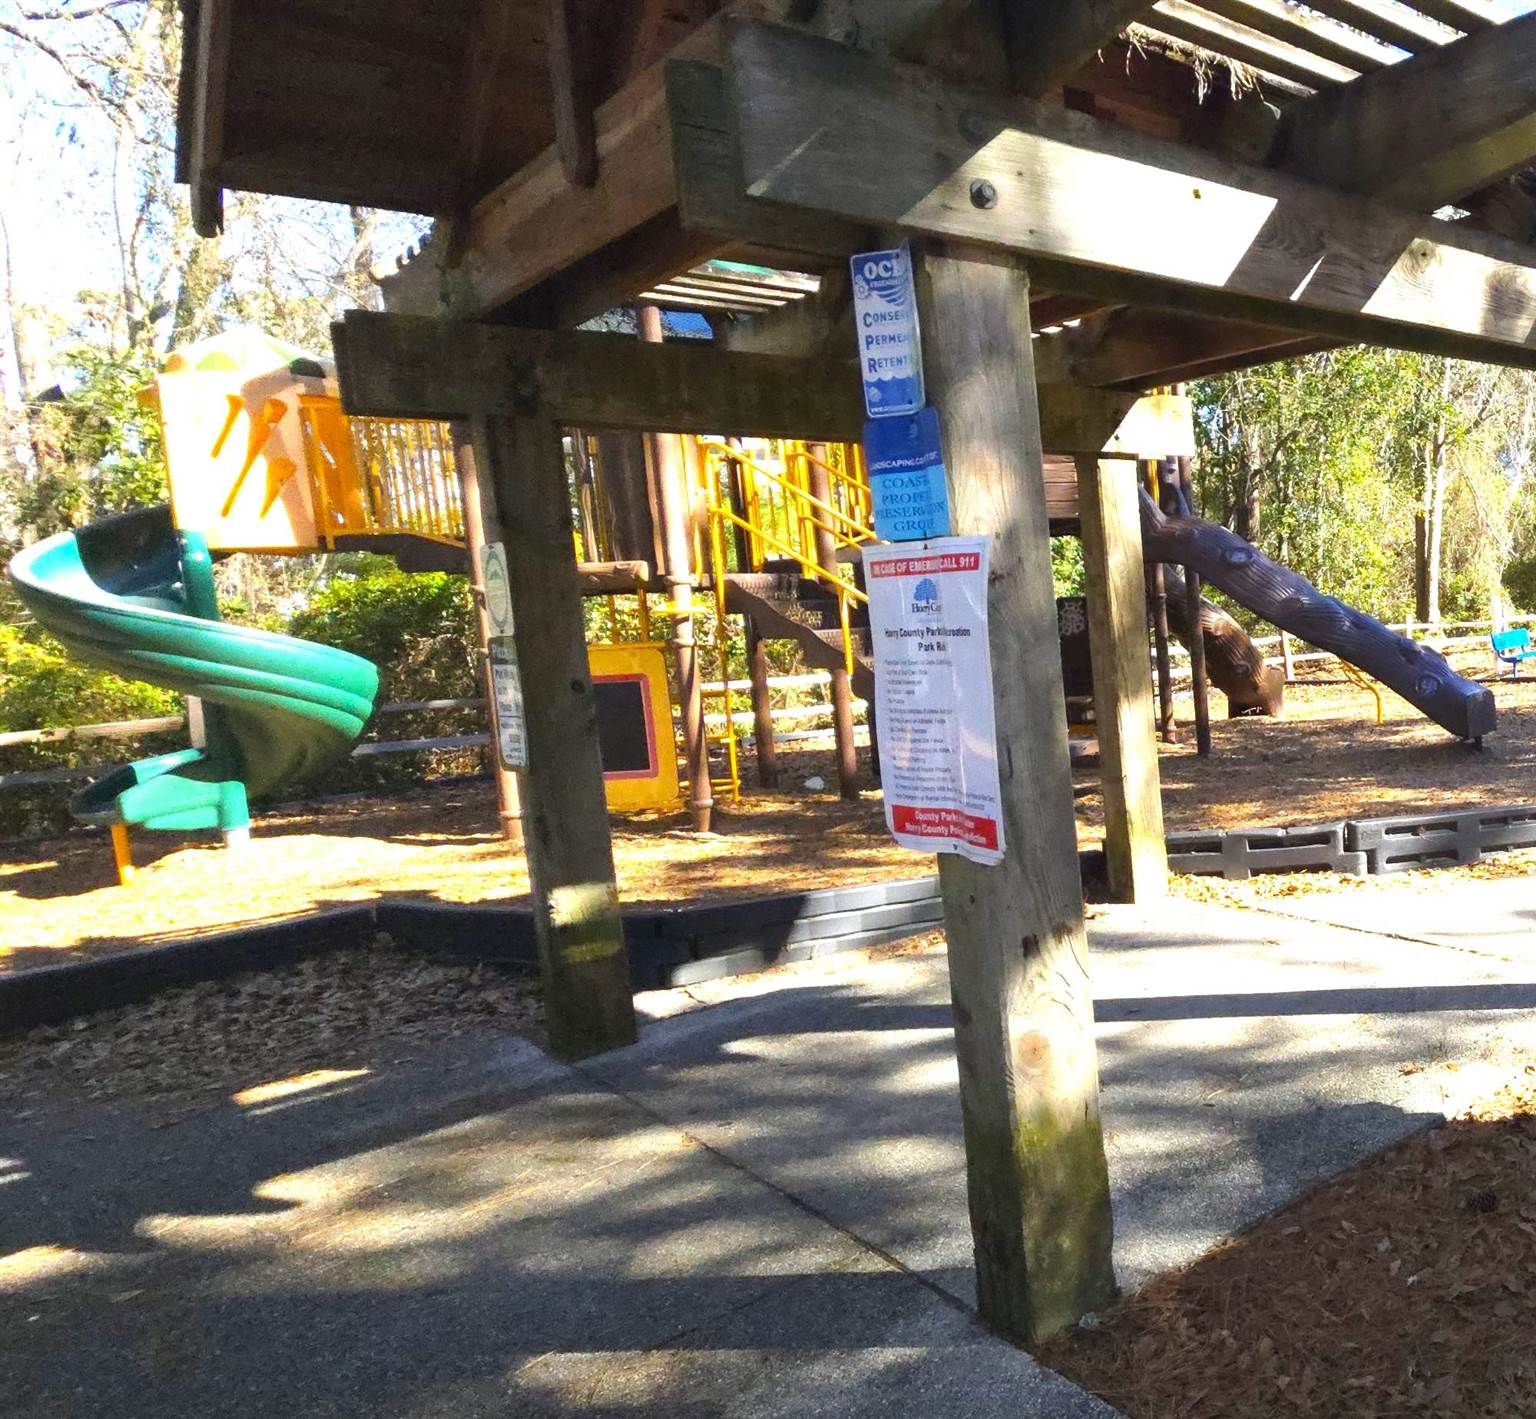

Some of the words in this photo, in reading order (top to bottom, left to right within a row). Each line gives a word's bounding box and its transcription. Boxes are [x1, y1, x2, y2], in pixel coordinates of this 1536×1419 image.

[897, 561, 908, 572] OF
[959, 556, 975, 567] 911
[900, 628, 925, 639] County
[918, 642, 935, 651] Park
